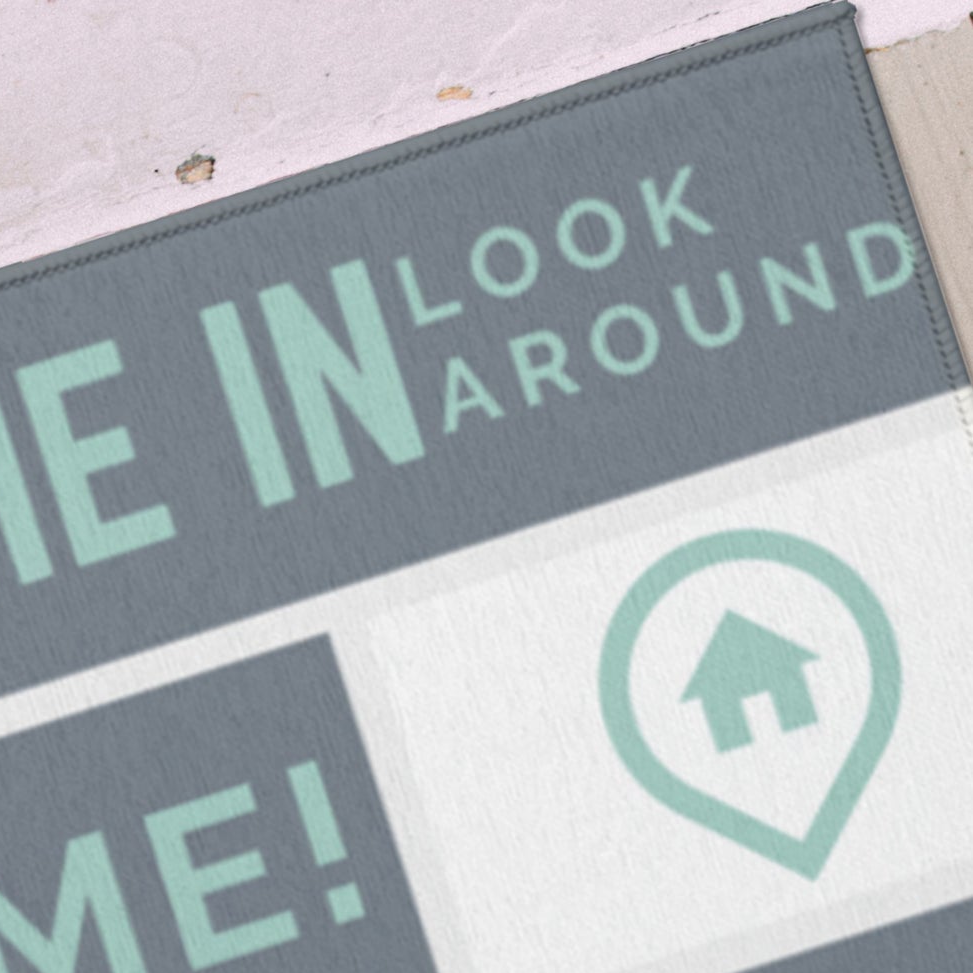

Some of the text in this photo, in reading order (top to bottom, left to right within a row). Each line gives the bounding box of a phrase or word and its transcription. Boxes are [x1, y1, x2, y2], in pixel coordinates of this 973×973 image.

[396, 165, 714, 326] LOOK
[443, 221, 919, 435] AROUND
[200, 258, 426, 508] IN
